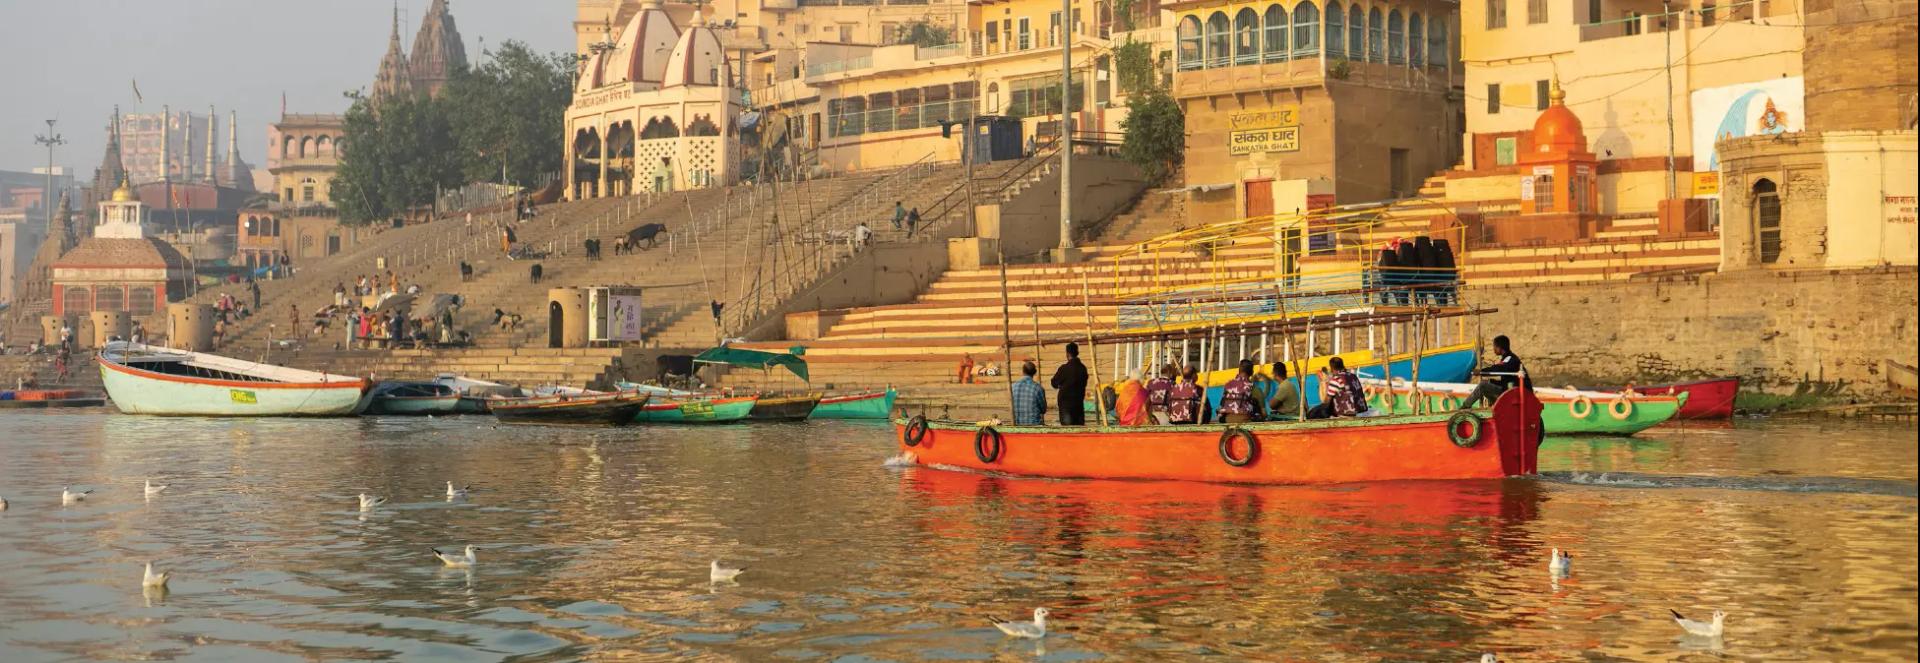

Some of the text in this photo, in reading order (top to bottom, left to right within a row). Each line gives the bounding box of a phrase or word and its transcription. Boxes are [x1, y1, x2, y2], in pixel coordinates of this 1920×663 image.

[1234, 130, 1295, 143] संकठा घाट
[1271, 142, 1294, 150] GHAT
